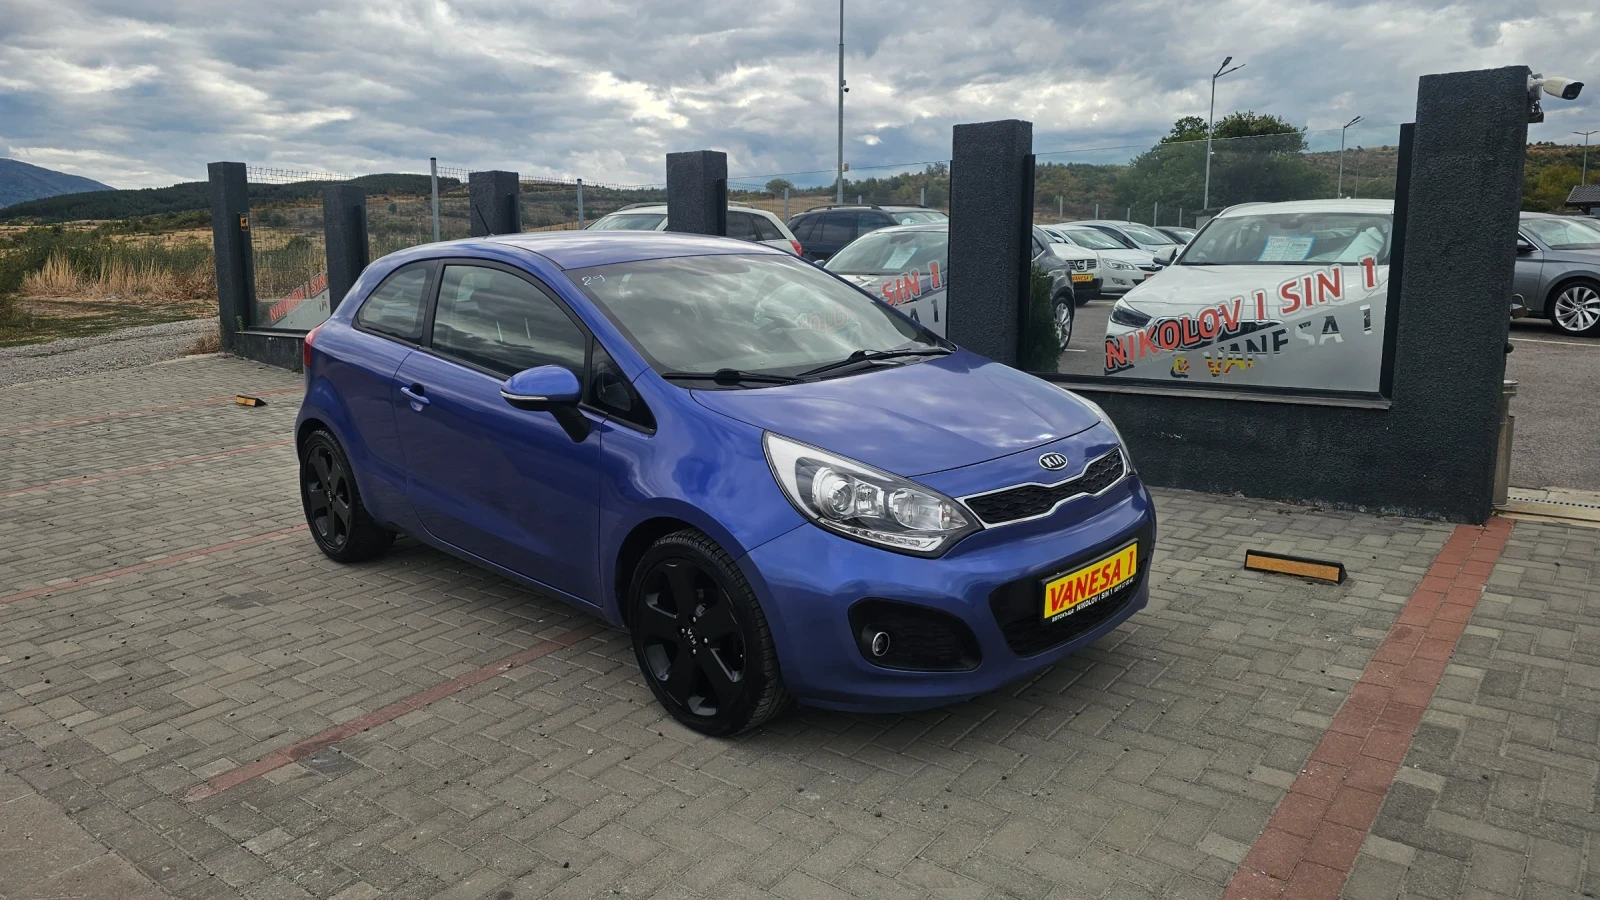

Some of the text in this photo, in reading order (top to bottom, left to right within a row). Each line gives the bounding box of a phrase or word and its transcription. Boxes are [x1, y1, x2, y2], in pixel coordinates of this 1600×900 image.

[581, 274, 606, 286] 29
[881, 263, 941, 306] SIN 1
[269, 285, 305, 322] NIKOLOV
[1105, 257, 1376, 369] NIKOLOV I SIN 1
[1203, 314, 1345, 377] VANESA
[1359, 304, 1374, 335] 1
[1042, 454, 1066, 468] KIA
[1050, 558, 1121, 612] VANESA
[1127, 550, 1134, 575] 1
[1076, 595, 1099, 612] NIKOLOV
